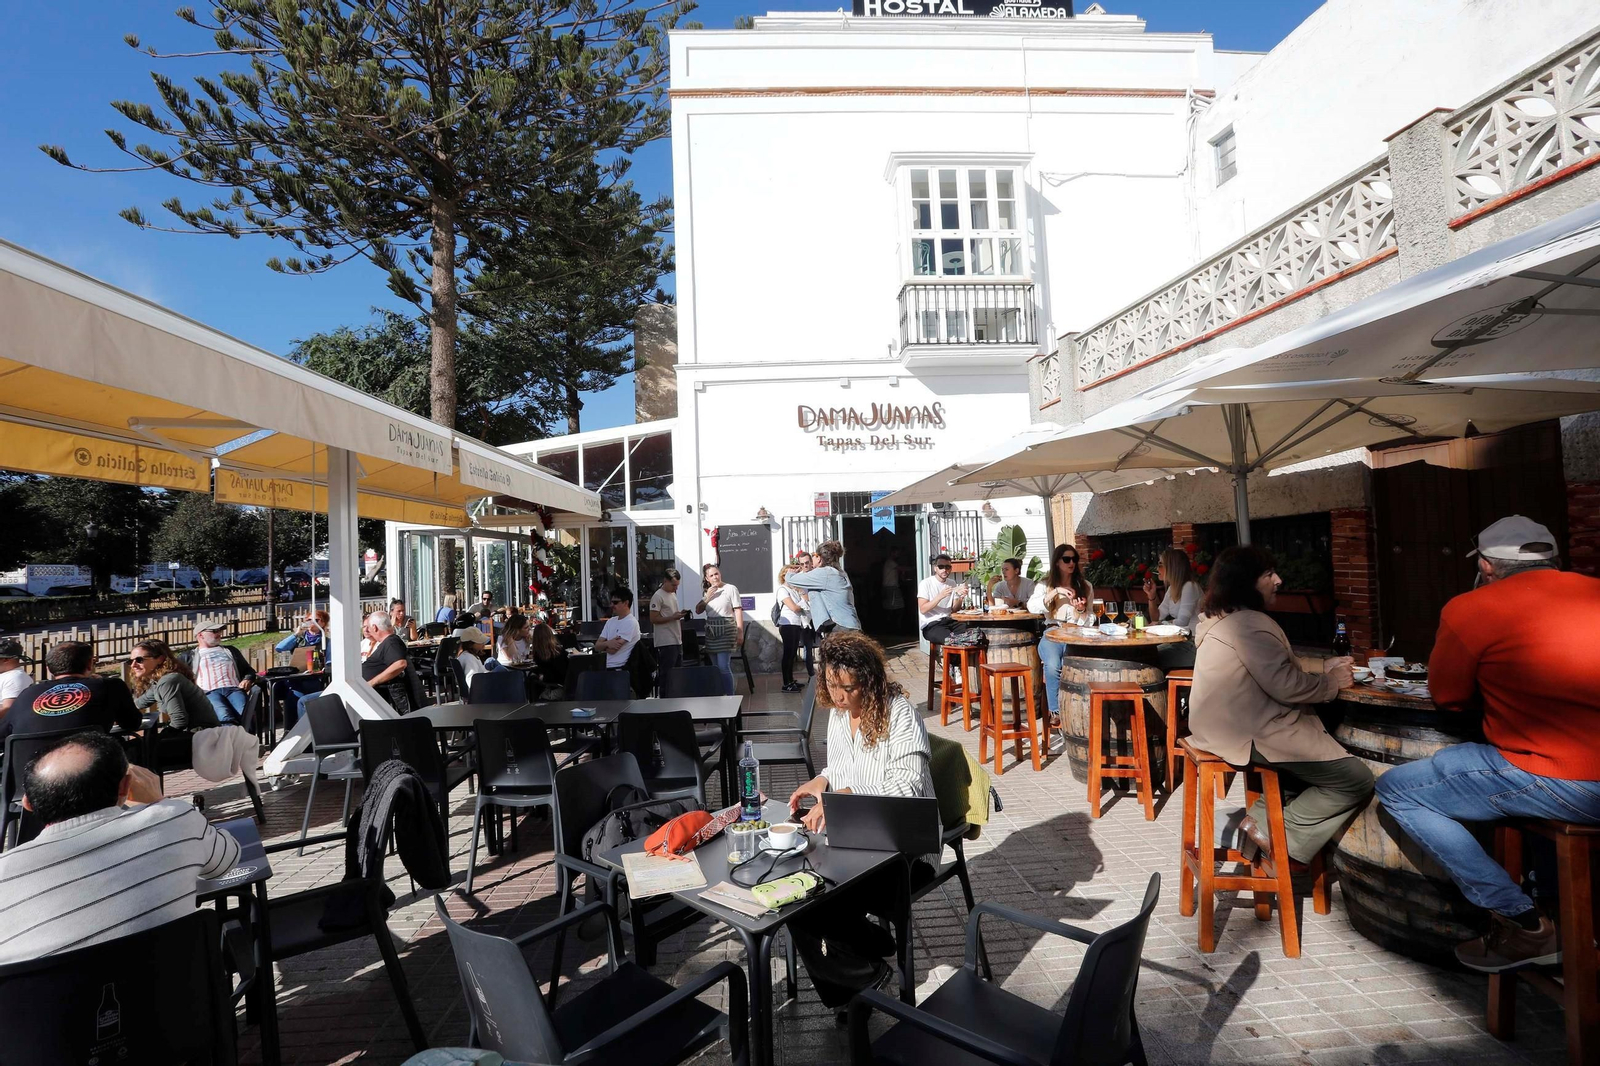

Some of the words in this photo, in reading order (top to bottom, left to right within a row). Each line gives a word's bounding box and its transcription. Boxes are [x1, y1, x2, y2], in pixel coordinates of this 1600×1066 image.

[864, 0, 975, 17] HOSTAL
[1005, 7, 1067, 18] ALAMEDA
[816, 435, 862, 449] Tapas
[870, 434, 896, 446] Del
[903, 434, 932, 446] Sur
